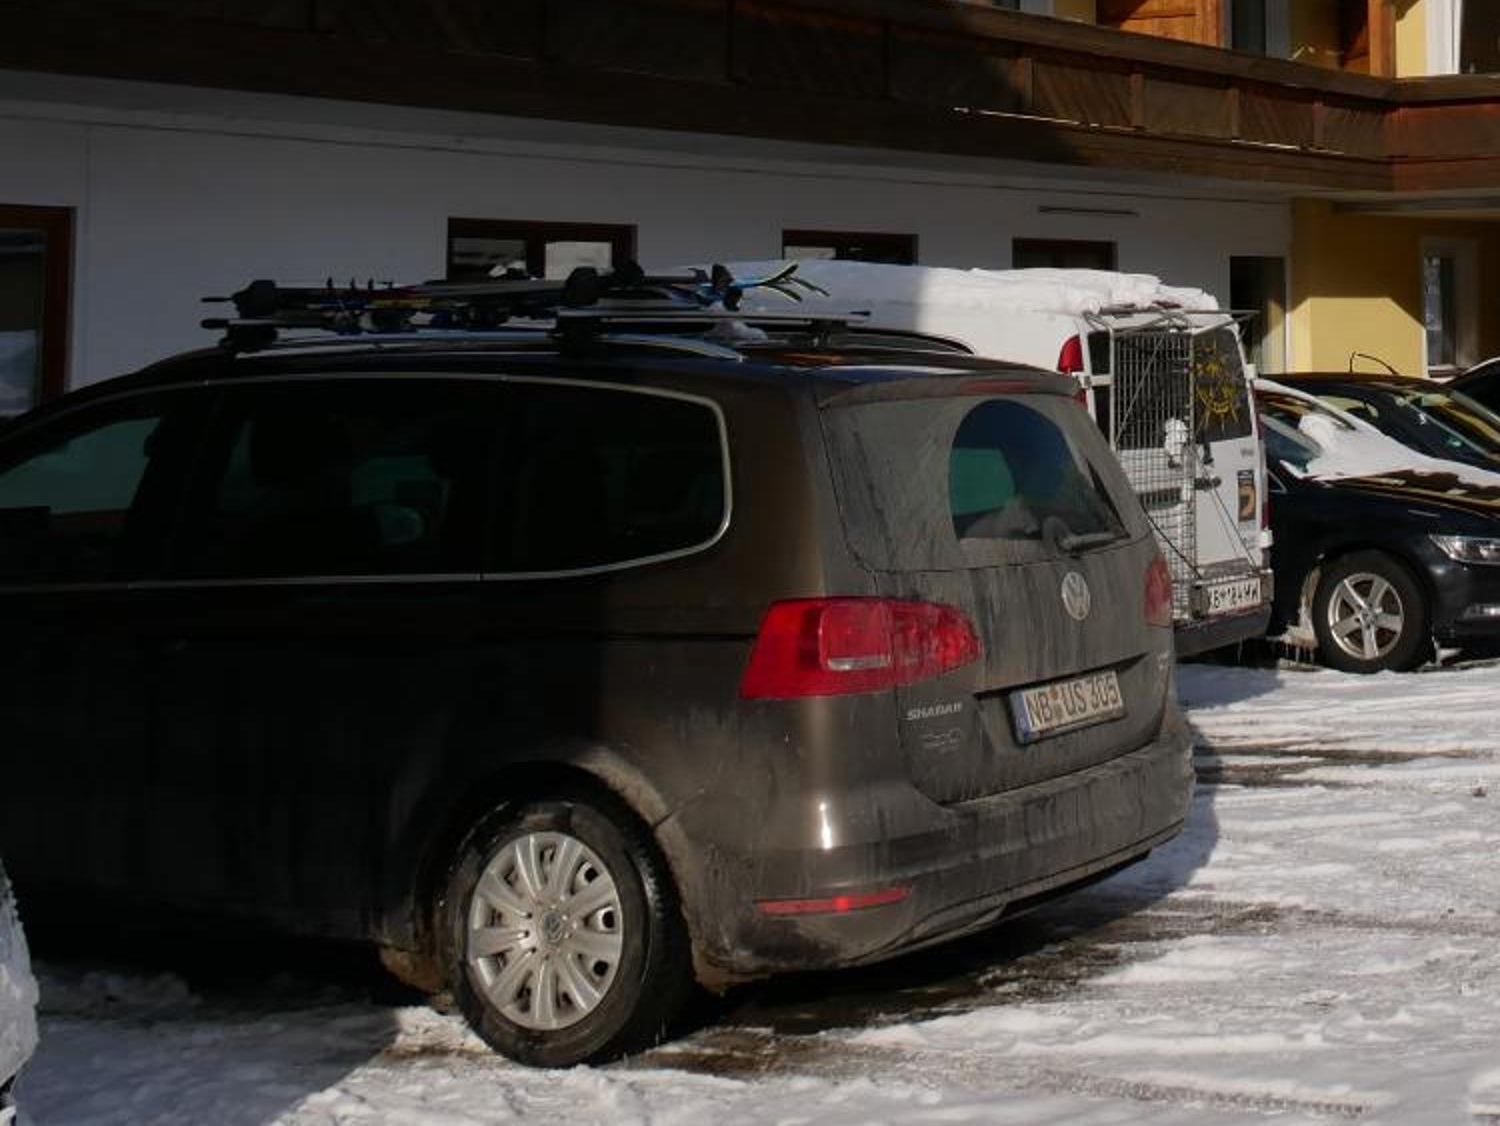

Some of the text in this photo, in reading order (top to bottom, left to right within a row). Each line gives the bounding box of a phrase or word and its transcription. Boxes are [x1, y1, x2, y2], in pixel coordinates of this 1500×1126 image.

[1025, 673, 1120, 727] NB US 305
